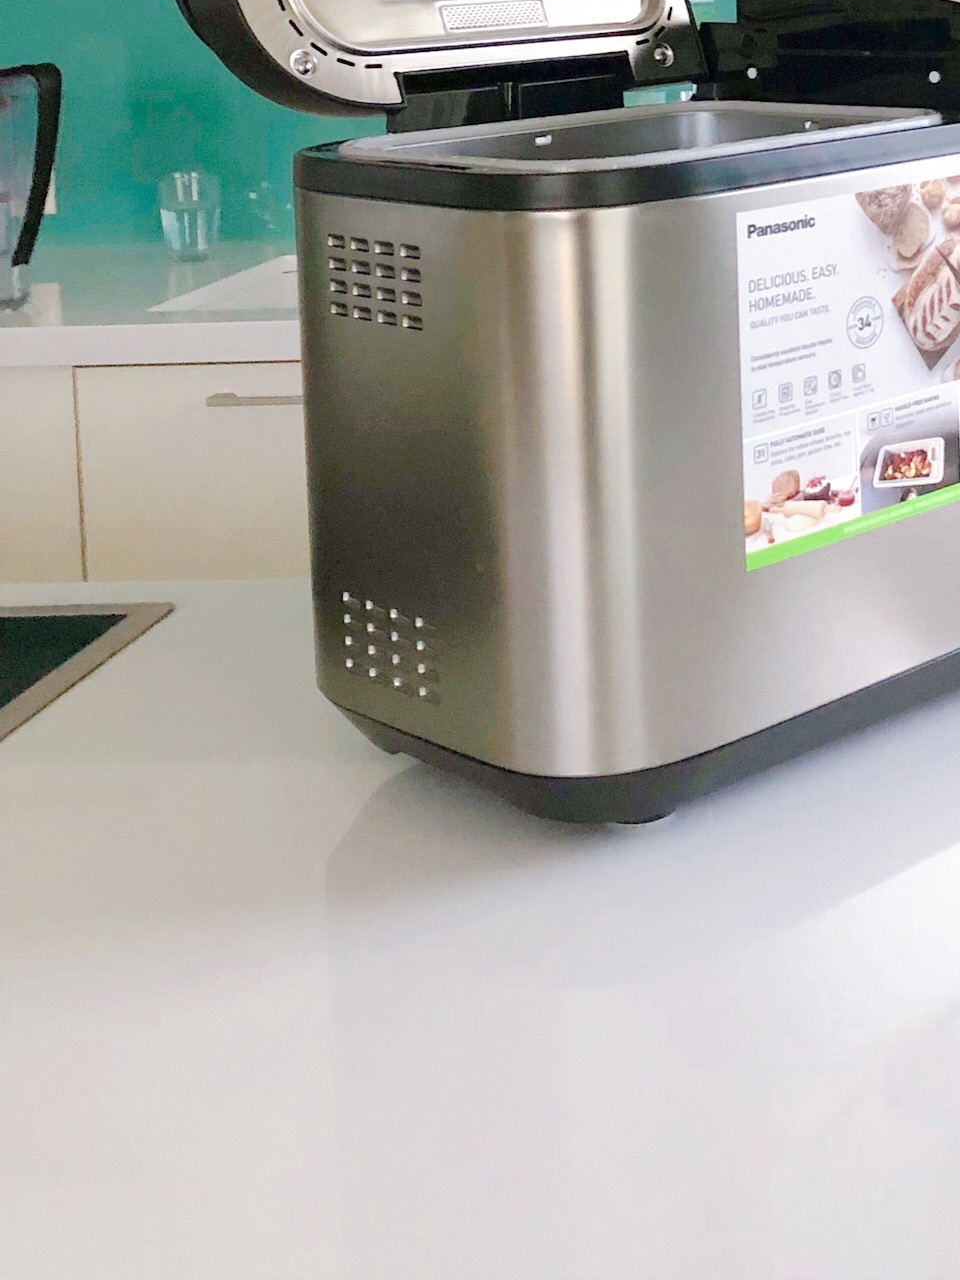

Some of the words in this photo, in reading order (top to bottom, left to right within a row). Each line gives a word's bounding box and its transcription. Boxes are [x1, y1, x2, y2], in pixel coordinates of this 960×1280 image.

[746, 214, 816, 239] Panasonic
[748, 270, 809, 293] DELICIOUS.
[811, 263, 839, 280] EASY.
[749, 287, 816, 313] HOMEMADE.
[749, 313, 779, 329] QUALITY
[779, 311, 794, 323] YOU
[794, 308, 809, 320] CAN
[857, 314, 872, 331] 34
[756, 449, 766, 459] 31
